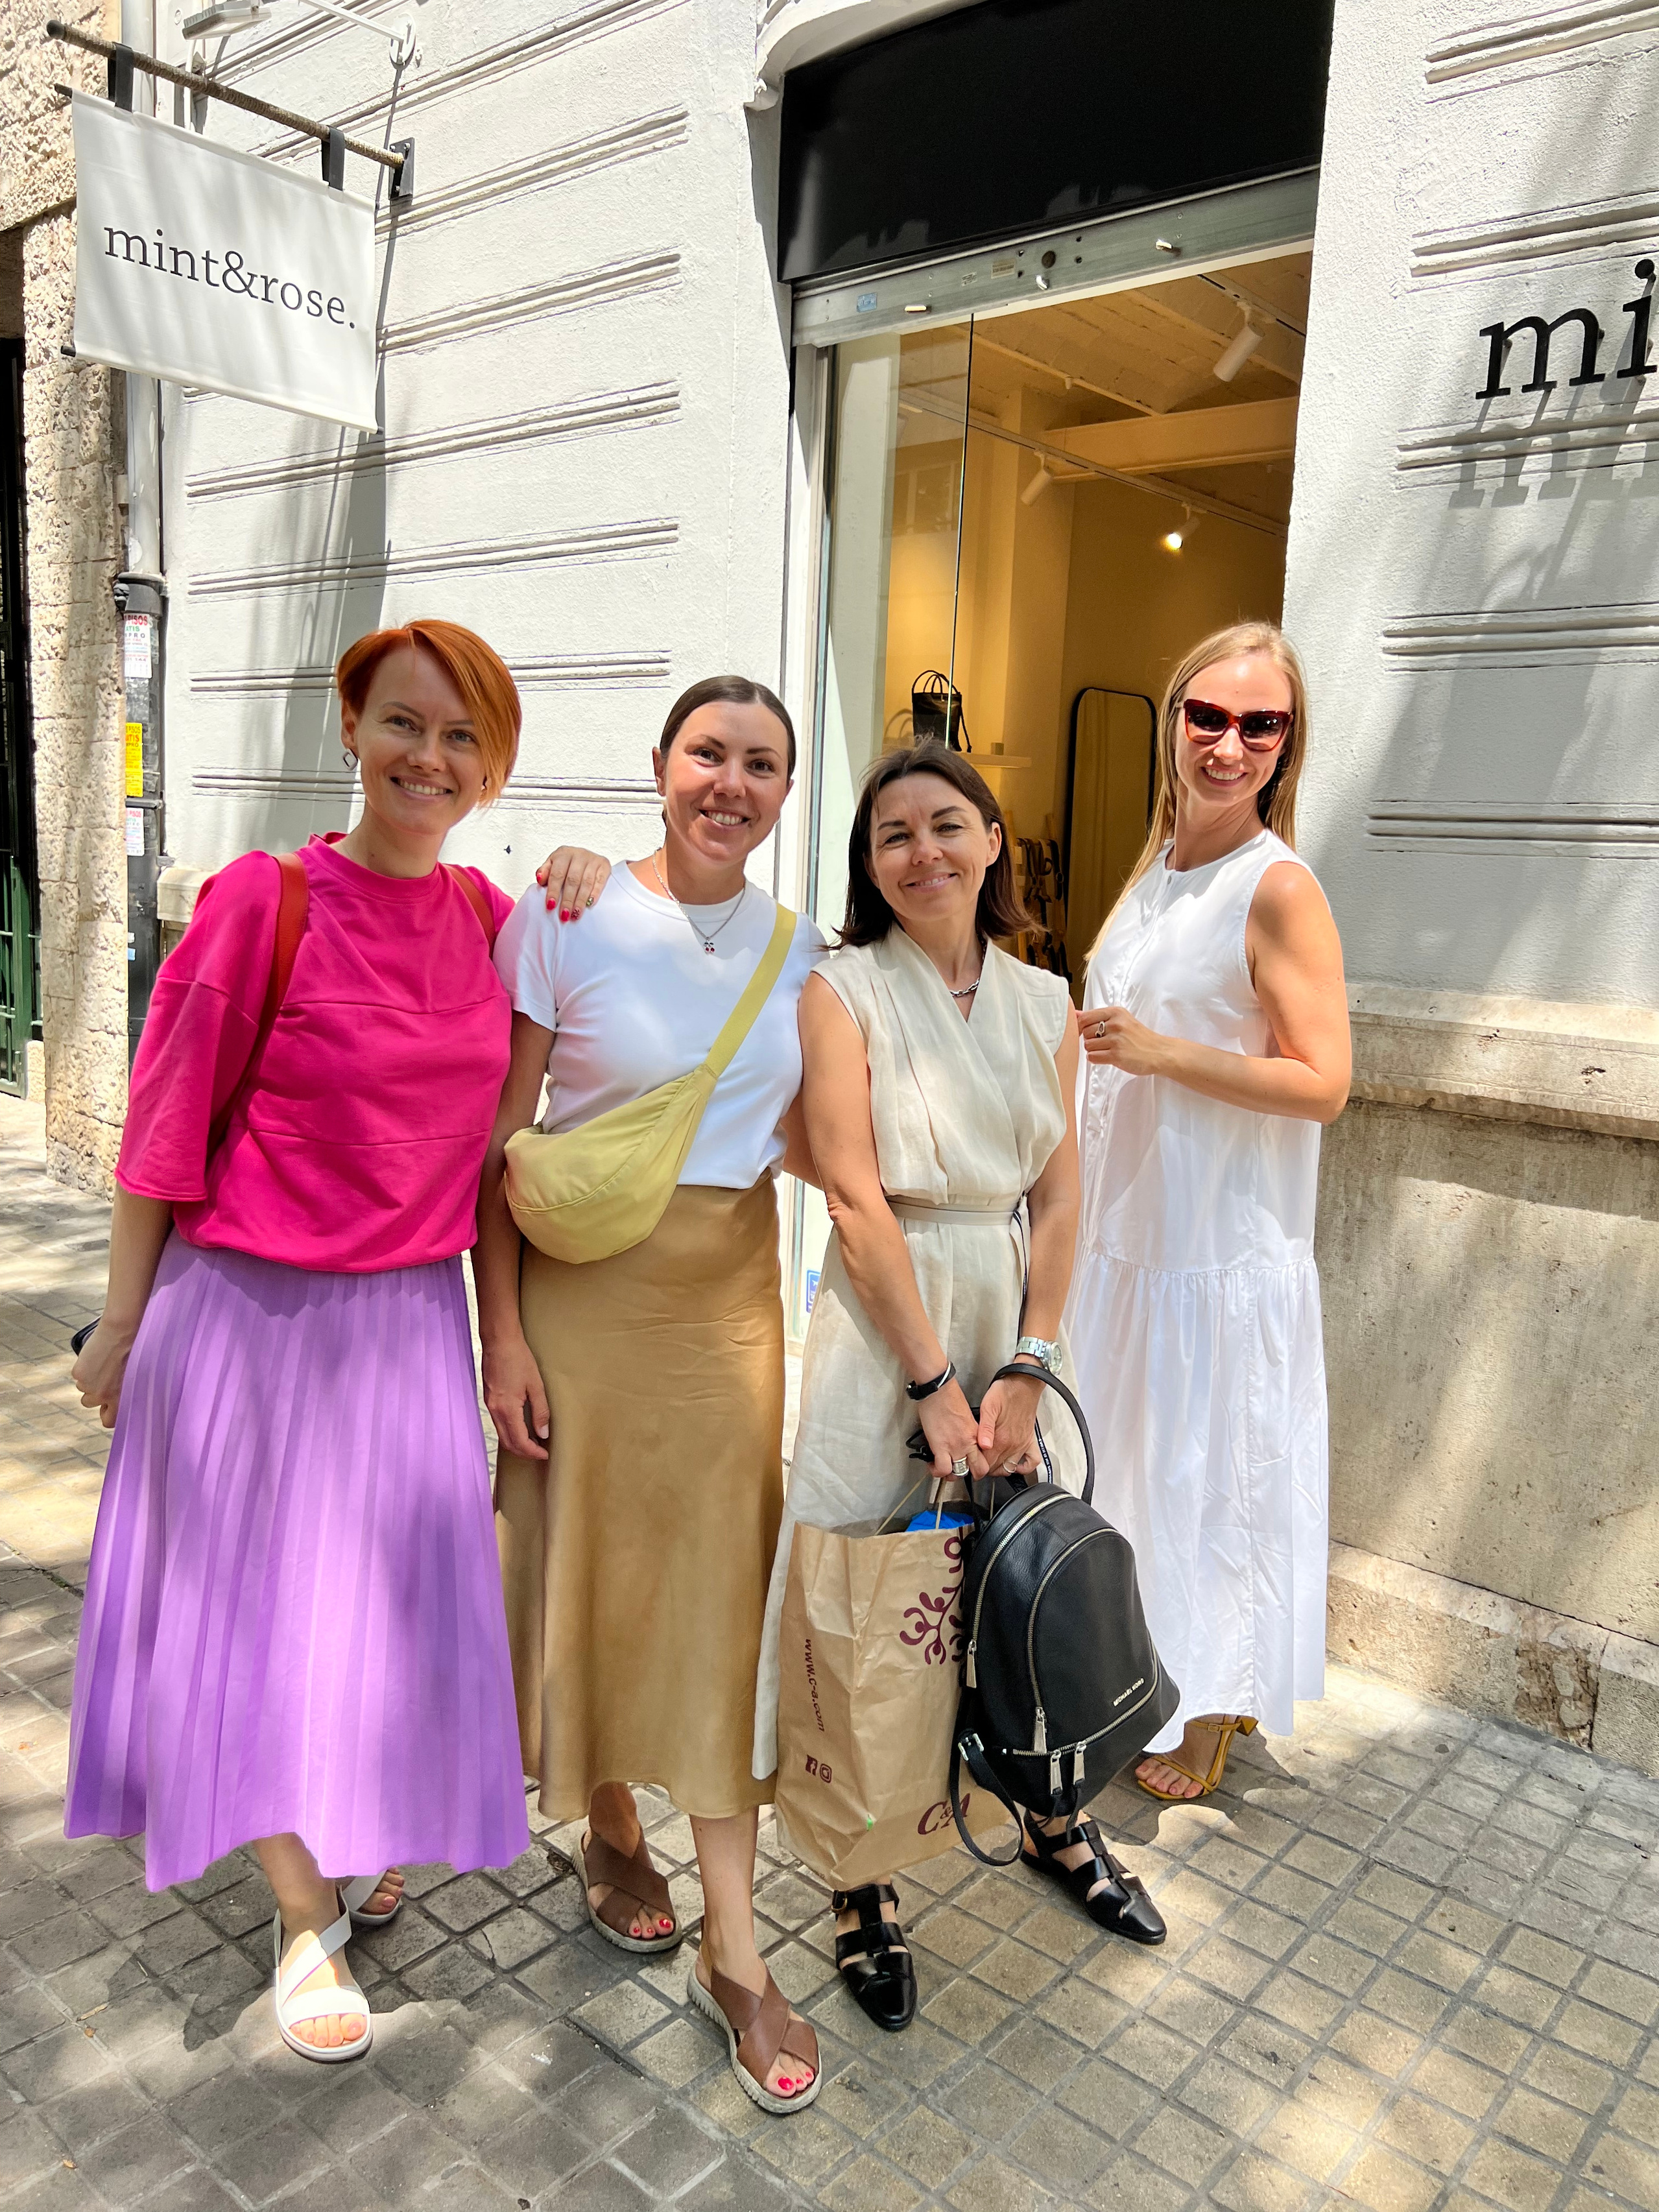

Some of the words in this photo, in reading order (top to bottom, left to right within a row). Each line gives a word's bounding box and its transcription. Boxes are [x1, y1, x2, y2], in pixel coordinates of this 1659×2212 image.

[104, 227, 355, 329] mint&rose.
[1475, 258, 1658, 400] mi
[804, 1639, 825, 1732] www.c-a.com
[1113, 1688, 1132, 1707] MICHAEL
[1131, 1678, 1144, 1691] KORS
